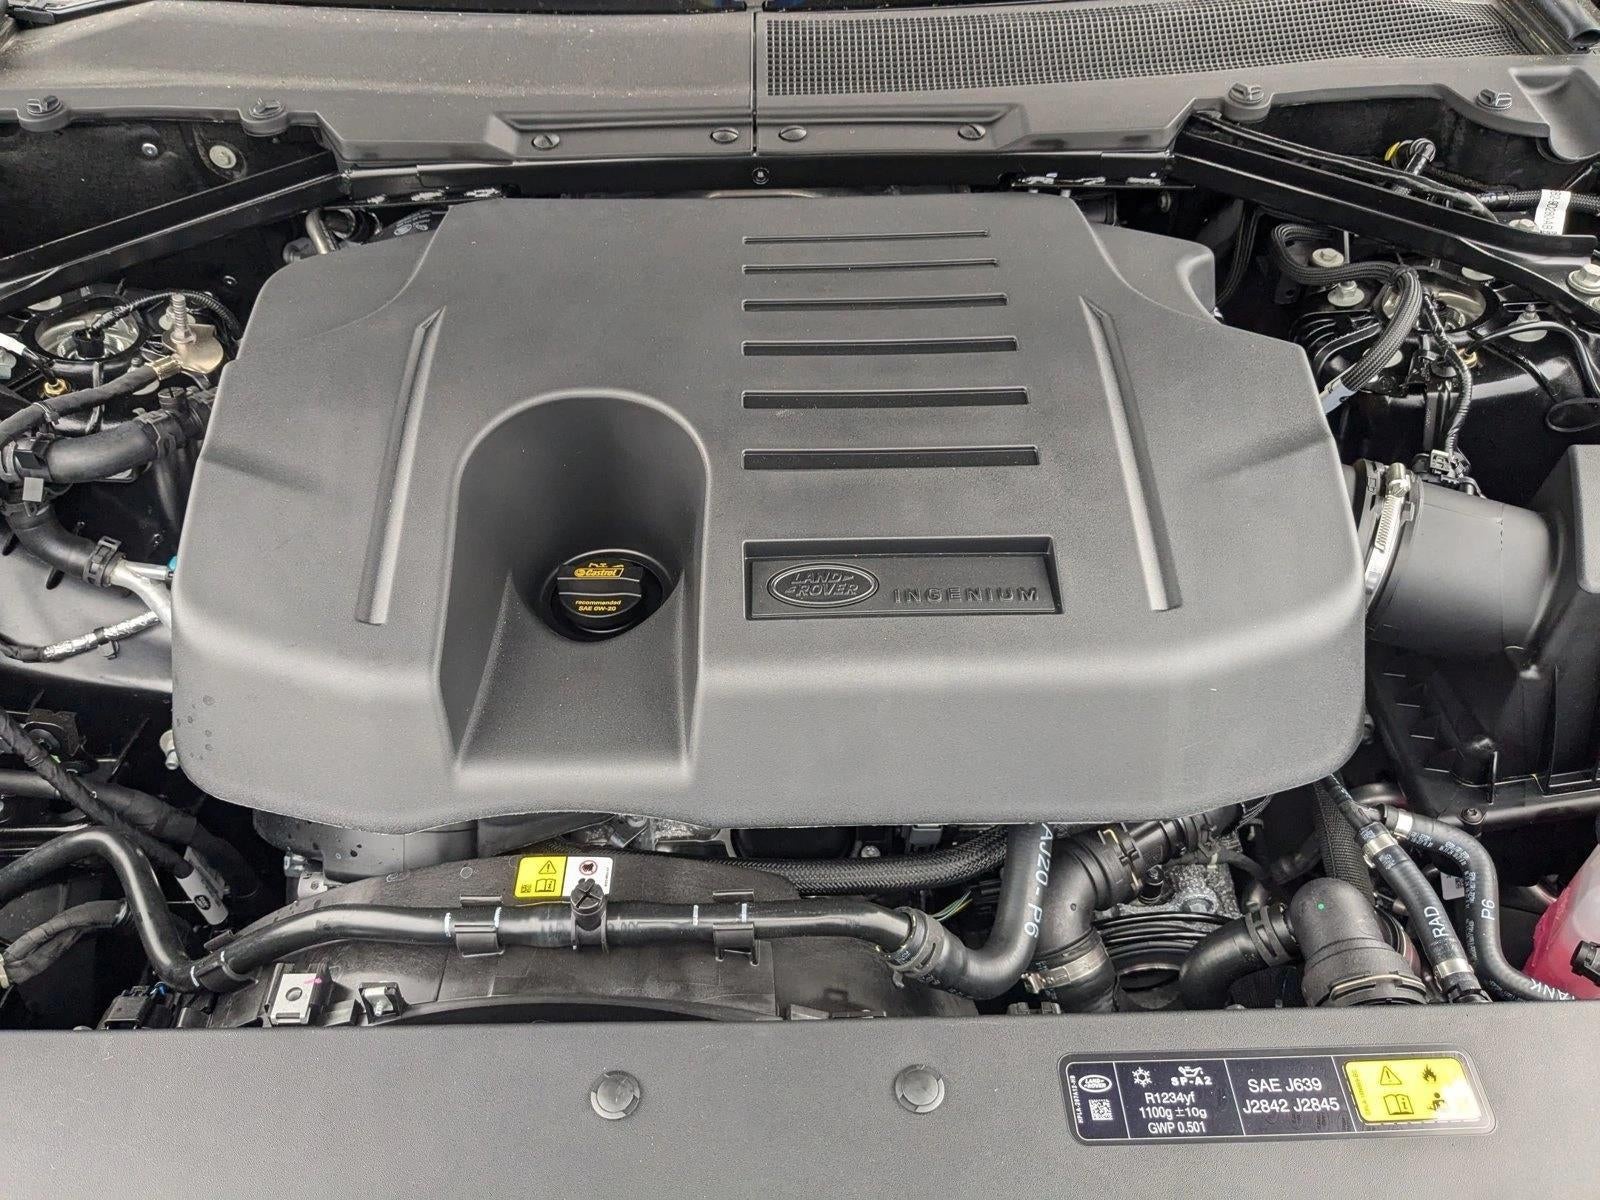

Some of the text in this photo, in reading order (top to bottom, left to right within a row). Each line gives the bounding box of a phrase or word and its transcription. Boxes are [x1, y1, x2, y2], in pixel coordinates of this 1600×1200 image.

[790, 572, 840, 584] LAND
[794, 583, 859, 597] ROVER
[893, 586, 1041, 604] INGENIUM
[1481, 898, 1496, 920] P6
[1424, 906, 1449, 938] RAD
[1530, 978, 1576, 1001] ANK
[1171, 1076, 1213, 1086] SP-A2
[1248, 1077, 1322, 1093] SAE J639
[1144, 1091, 1196, 1106] R1234yf
[1243, 1097, 1340, 1114] J2842 J2845
[1139, 1106, 1173, 1120] 1100g
[1148, 1121, 1206, 1134] GWP 0.501
